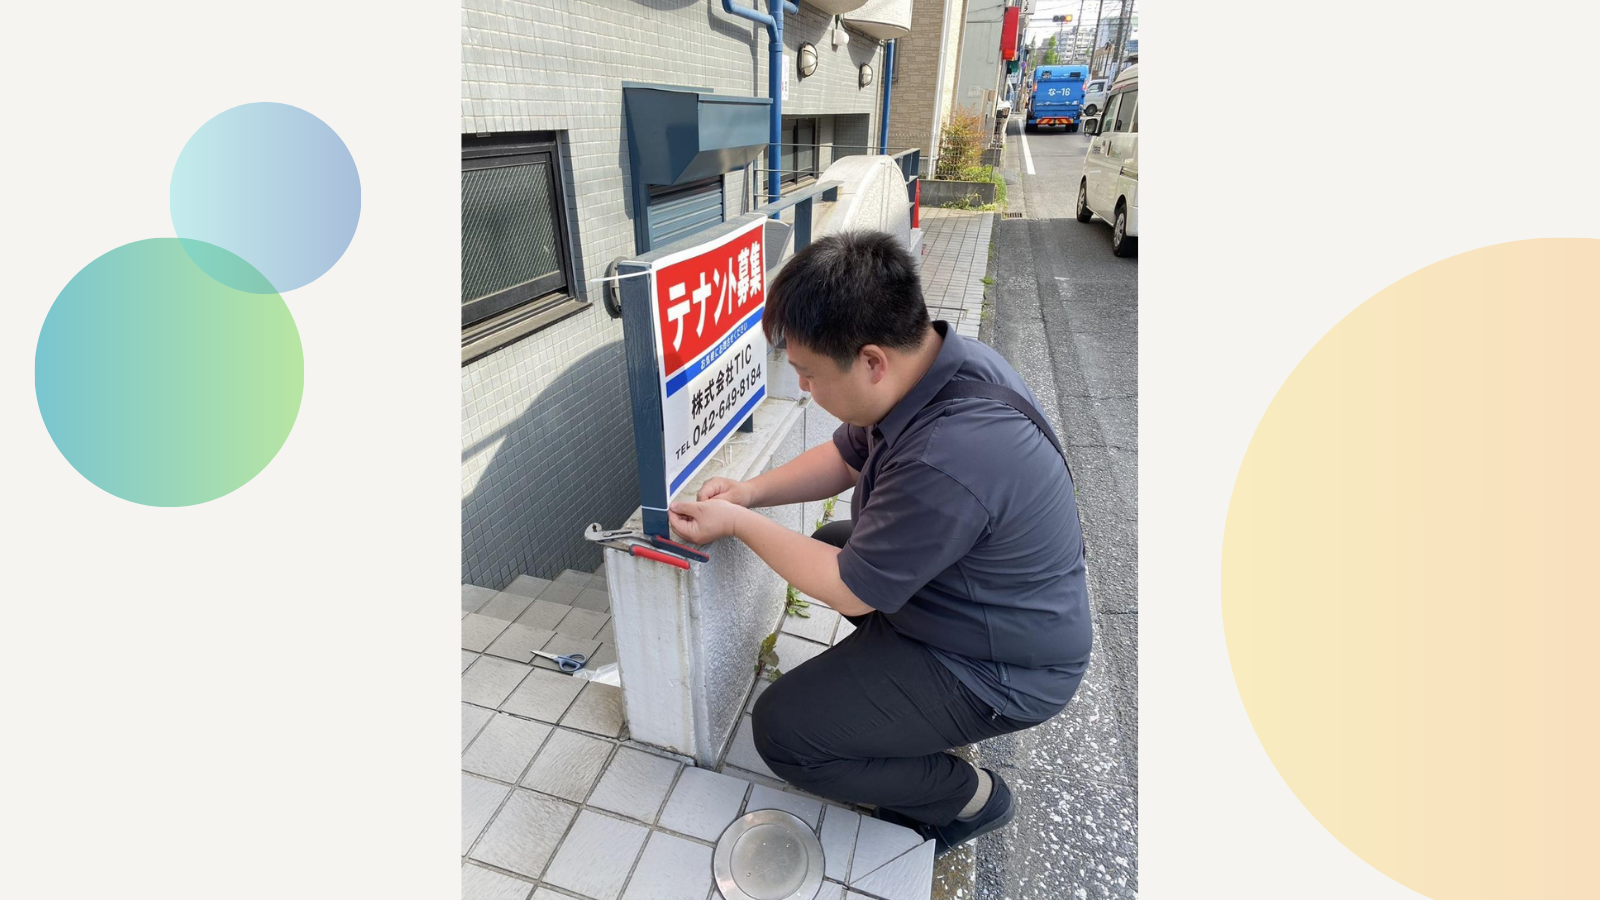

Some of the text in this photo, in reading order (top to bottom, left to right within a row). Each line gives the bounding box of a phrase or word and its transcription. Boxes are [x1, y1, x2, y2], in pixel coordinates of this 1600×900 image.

[667, 241, 761, 352] テナント募集
[675, 363, 762, 460] TEL 042-649-8184
[691, 344, 752, 420] 株式会社TIC
